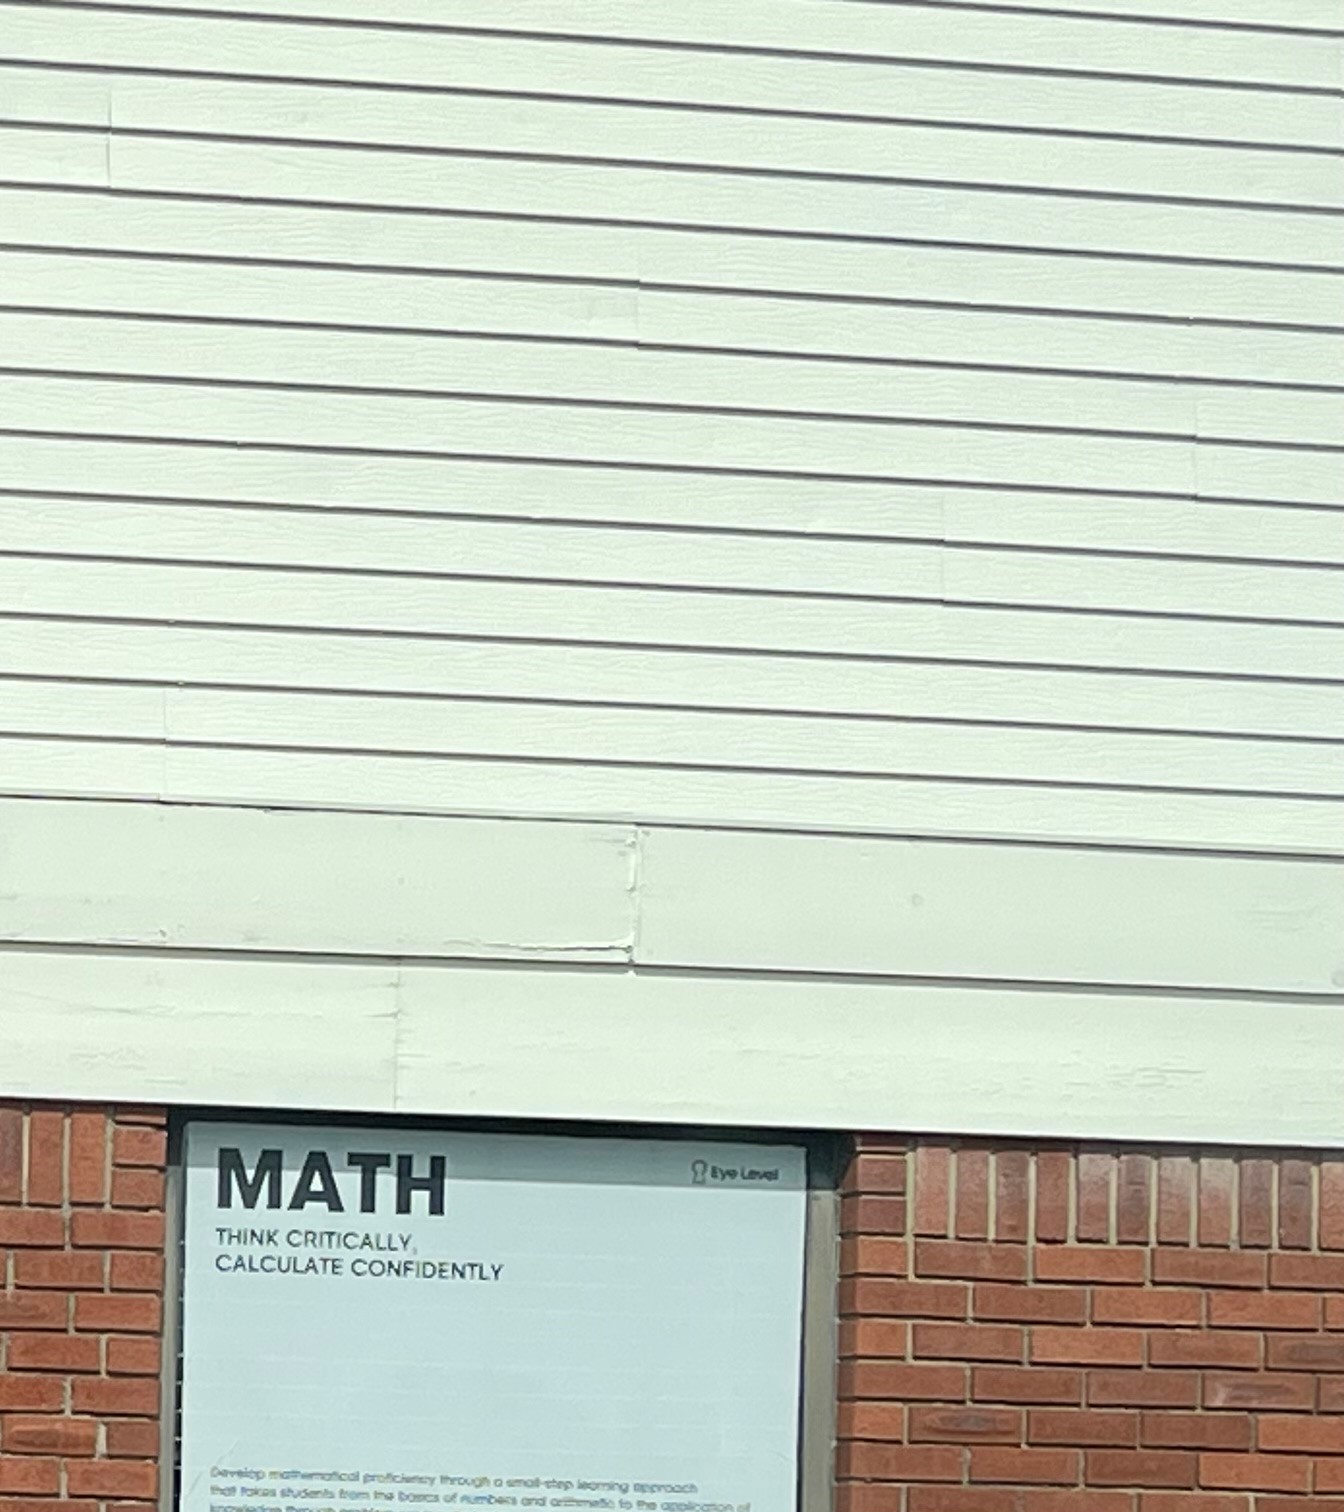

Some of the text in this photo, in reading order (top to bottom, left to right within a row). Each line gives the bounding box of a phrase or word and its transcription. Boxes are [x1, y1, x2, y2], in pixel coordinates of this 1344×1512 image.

[217, 1147, 447, 1216] MATH
[711, 1165, 778, 1182] Eye Level
[216, 1228, 418, 1254] THINK CRITICALLY,
[215, 1254, 504, 1282] CALCULATE CONFIDENTLY
[210, 1466, 265, 1481] Develop
[269, 1470, 359, 1483] mathematical
[363, 1473, 436, 1487] proficiency
[440, 1474, 490, 1489] through
[494, 1479, 503, 1487] a
[577, 1479, 629, 1494] learning
[633, 1482, 698, 1495] approach
[210, 1485, 237, 1496] that
[240, 1486, 276, 1498] takes
[280, 1487, 335, 1499] students
[339, 1488, 370, 1500] from
[374, 1490, 394, 1500] the
[443, 1493, 457, 1503] of
[460, 1494, 517, 1505] numbers
[521, 1496, 546, 1506] and
[619, 1499, 632, 1510] to
[636, 1500, 657, 1511] the
